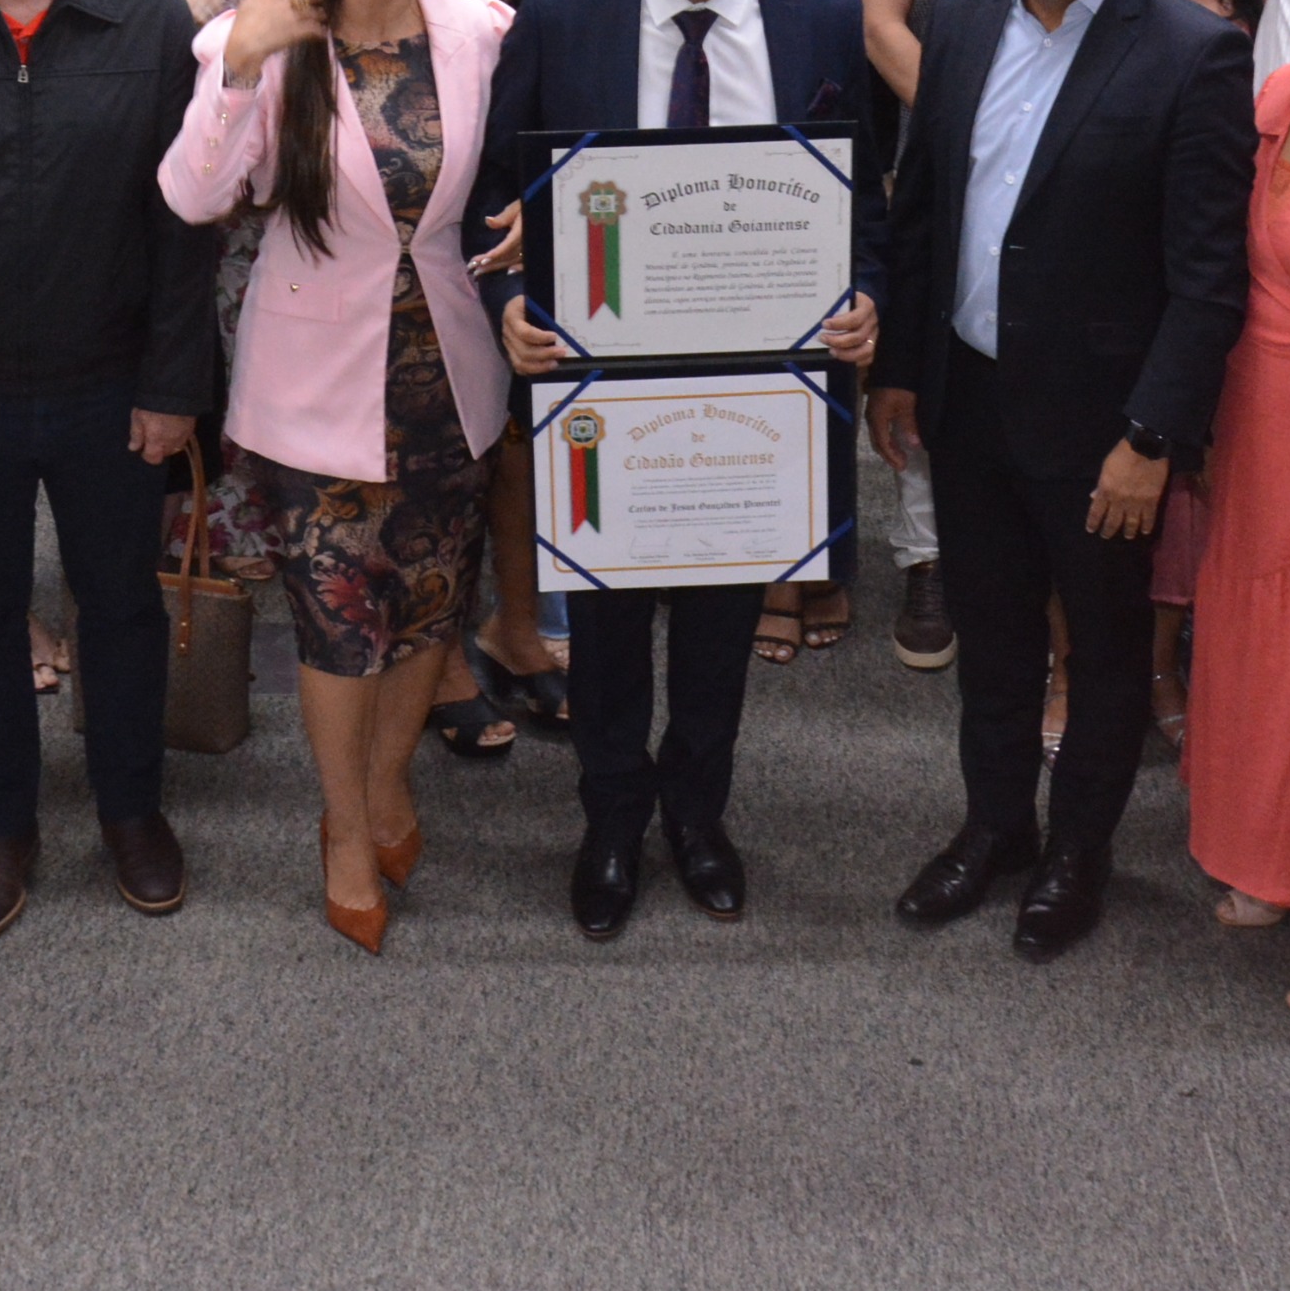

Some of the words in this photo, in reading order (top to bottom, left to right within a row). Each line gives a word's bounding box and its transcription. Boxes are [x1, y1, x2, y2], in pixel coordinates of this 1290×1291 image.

[640, 178, 721, 210] Diploma
[727, 173, 821, 204] Honorífico
[723, 201, 737, 212] de
[649, 222, 724, 236] Cidadania
[727, 219, 811, 235] Goianiense
[626, 408, 697, 442] Diploma
[703, 403, 782, 443] Honorífico
[691, 431, 706, 443] de
[623, 453, 685, 471] Cidadão
[690, 452, 776, 468] Goianiense
